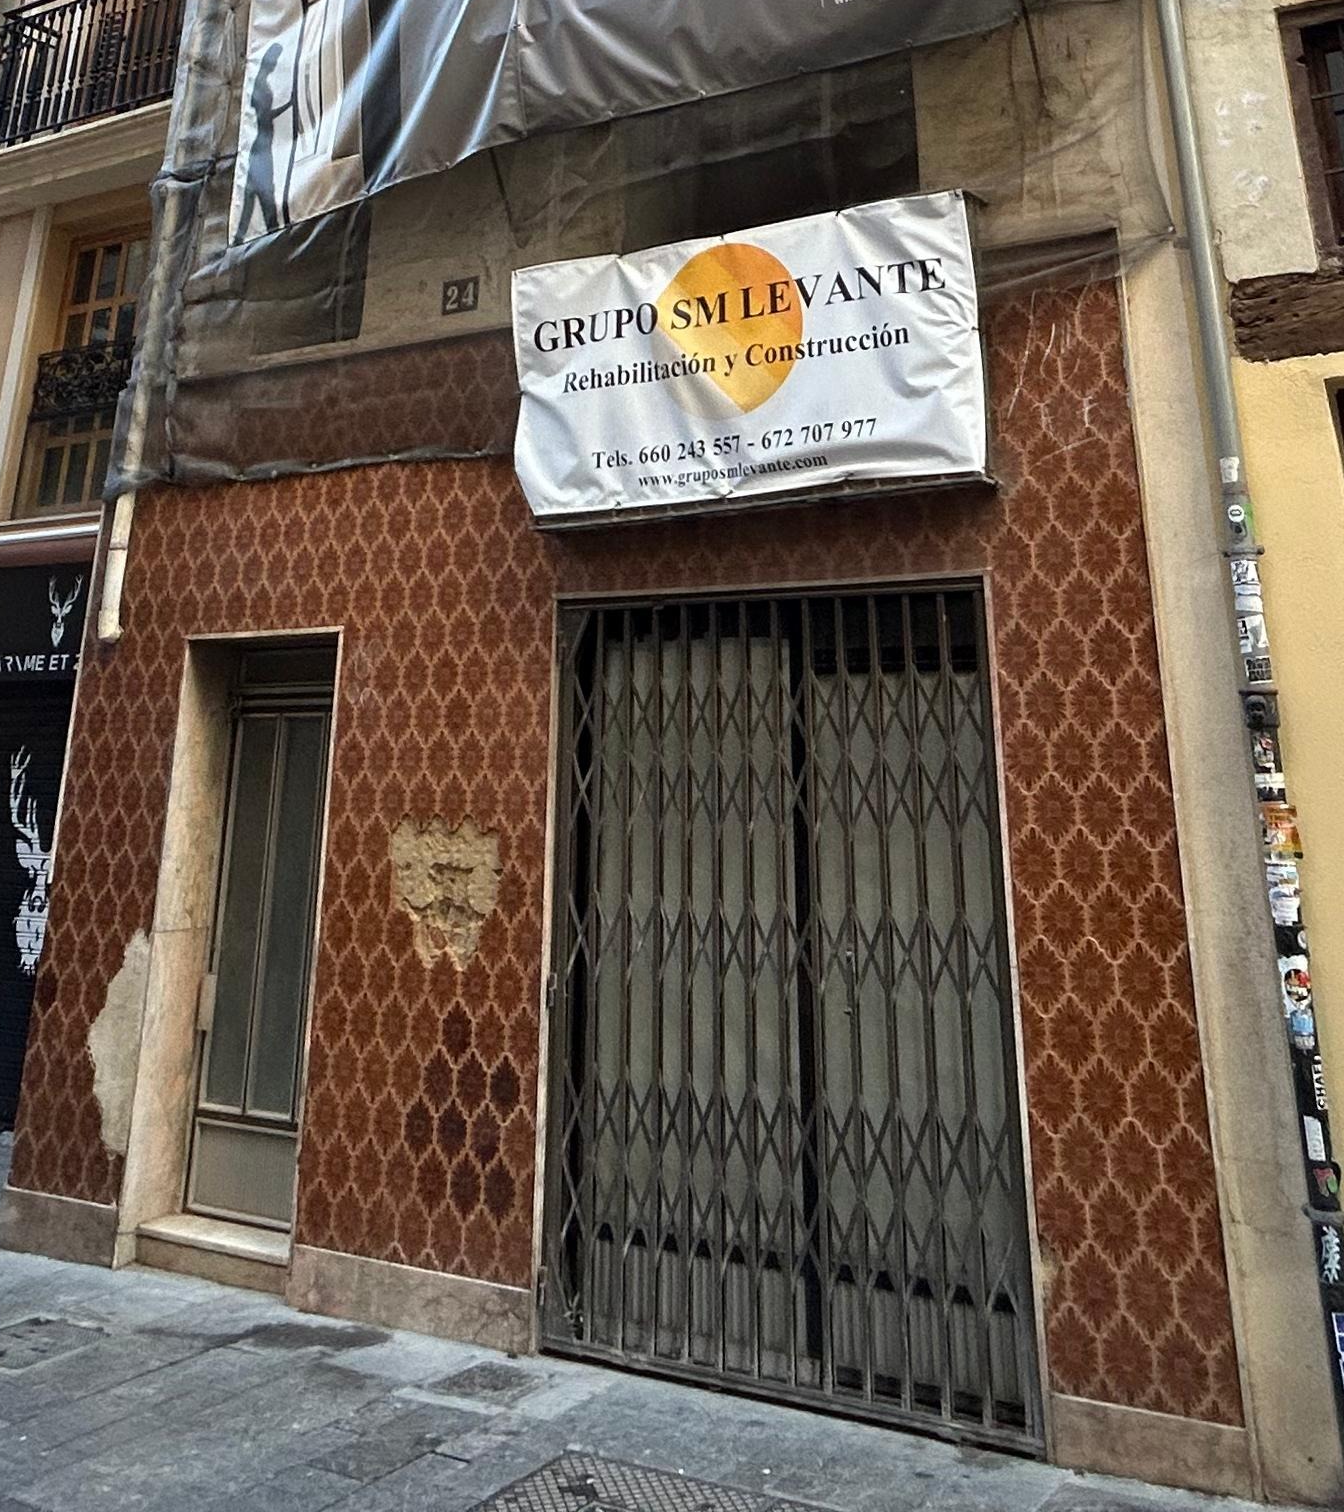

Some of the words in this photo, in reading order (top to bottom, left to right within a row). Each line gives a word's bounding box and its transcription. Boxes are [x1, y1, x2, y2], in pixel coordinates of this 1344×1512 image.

[446, 281, 475, 311] 24
[534, 302, 659, 353] GRUPO
[671, 291, 729, 330] SM
[740, 257, 946, 320] LEVANTE
[563, 352, 716, 393] Rehabilitación
[724, 353, 738, 377] y
[746, 323, 910, 367] Construcción
[592, 450, 632, 469] Tels.
[639, 445, 670, 465] 660
[677, 439, 706, 462] 243
[713, 435, 741, 457] 557
[761, 428, 793, 450] 672
[800, 422, 834, 445] 707
[841, 418, 878, 440] 977
[638, 453, 828, 488] www.gruposmlevante.com
[49, 654, 70, 670] ET
